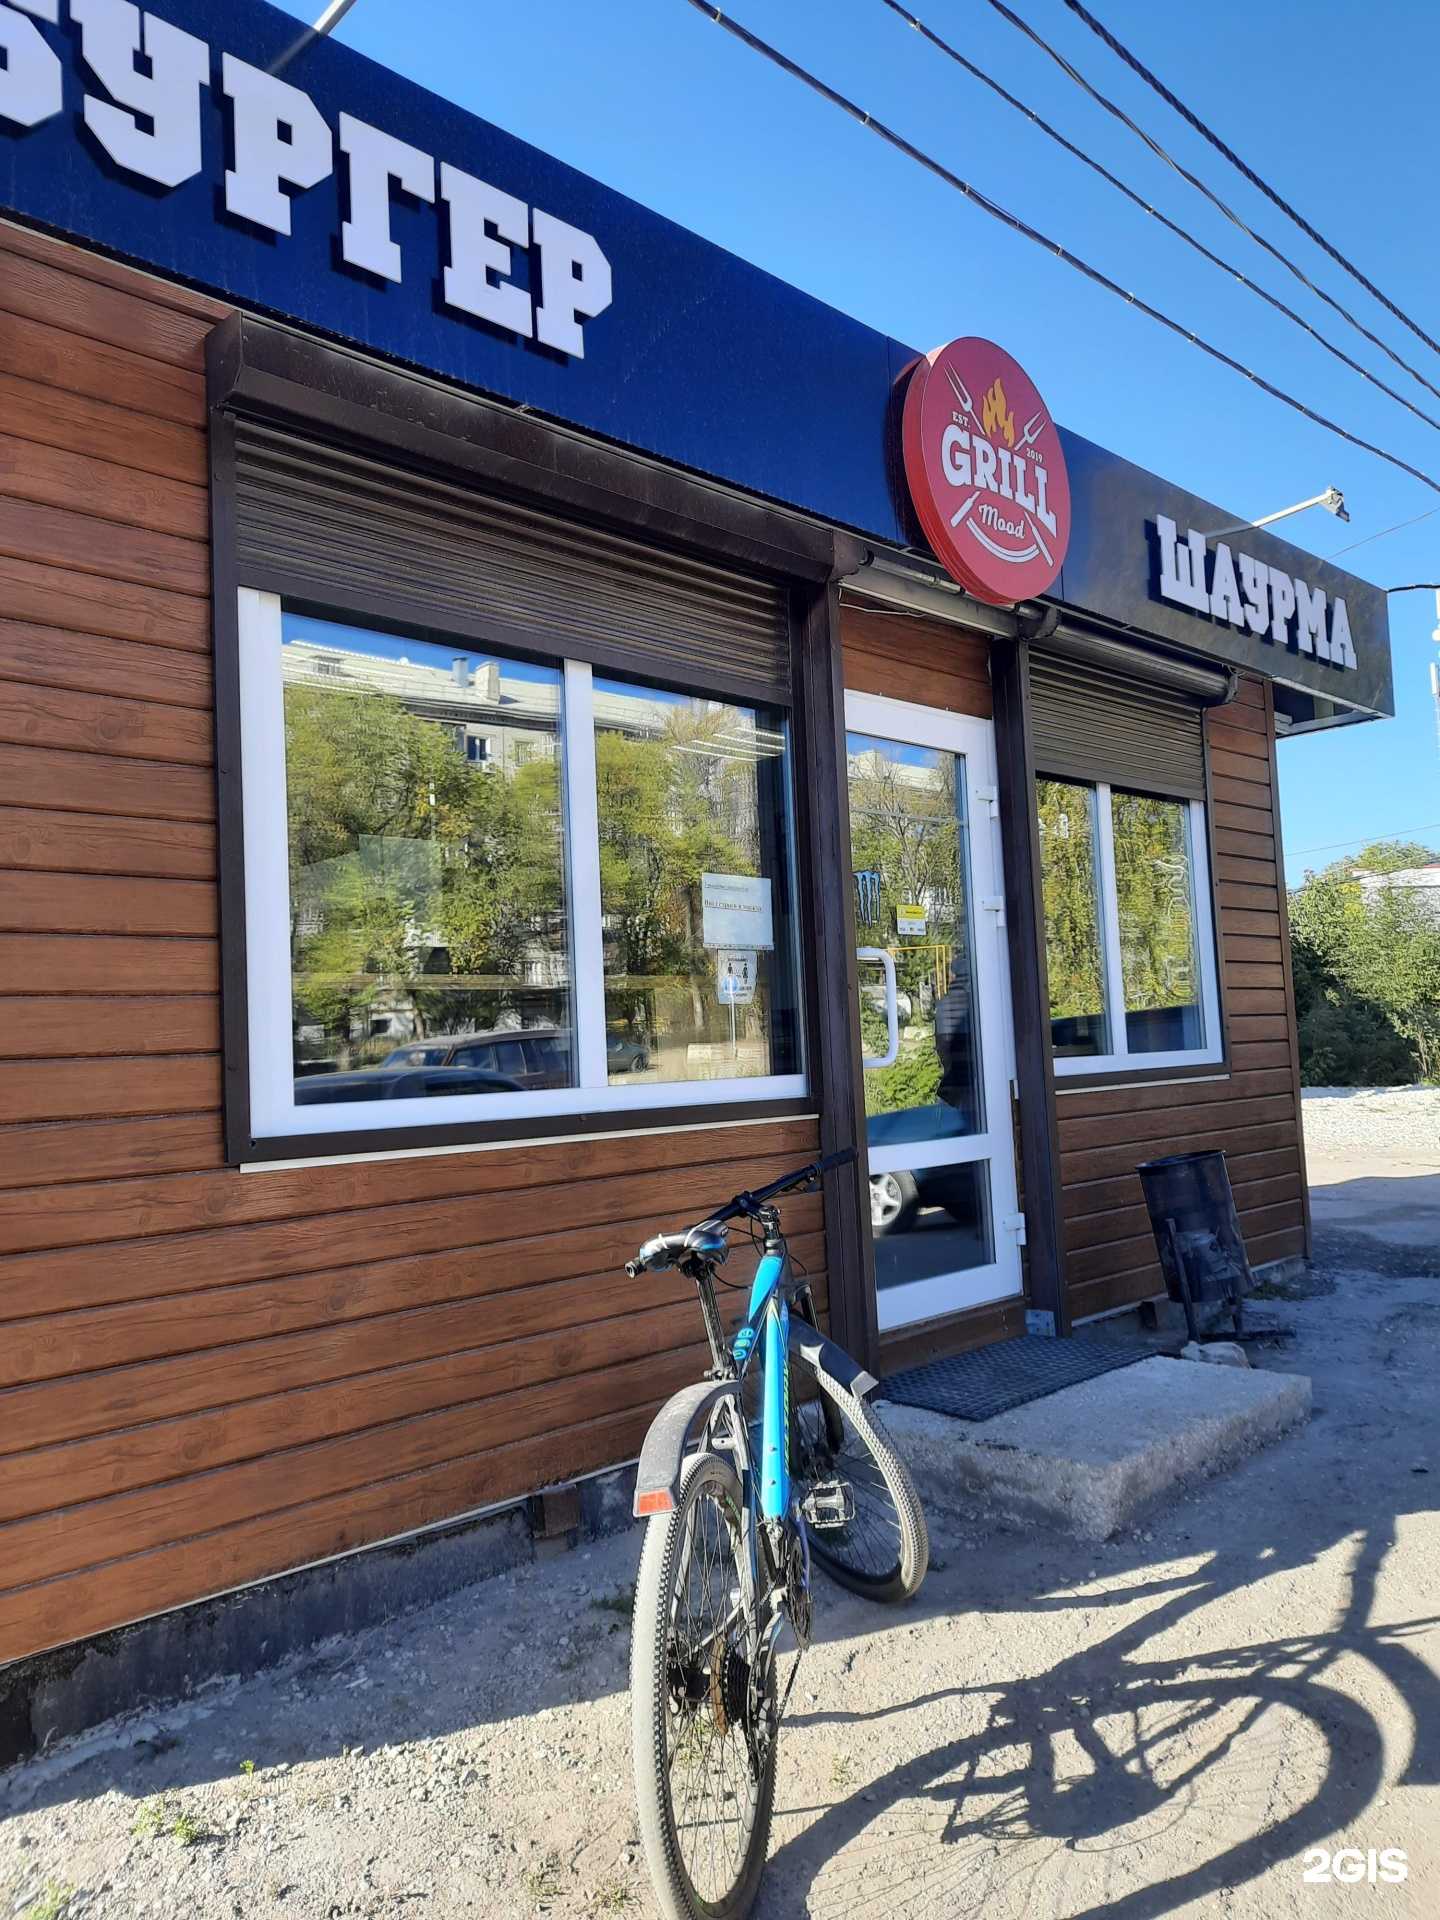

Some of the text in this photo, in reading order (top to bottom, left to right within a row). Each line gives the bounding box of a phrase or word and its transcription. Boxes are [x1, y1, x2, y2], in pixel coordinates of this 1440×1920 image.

[941, 424, 1057, 538] GRILL
[1026, 447, 1043, 464] 2019
[978, 503, 1025, 539] Mood
[1157, 514, 1358, 670] ШАУРМА
